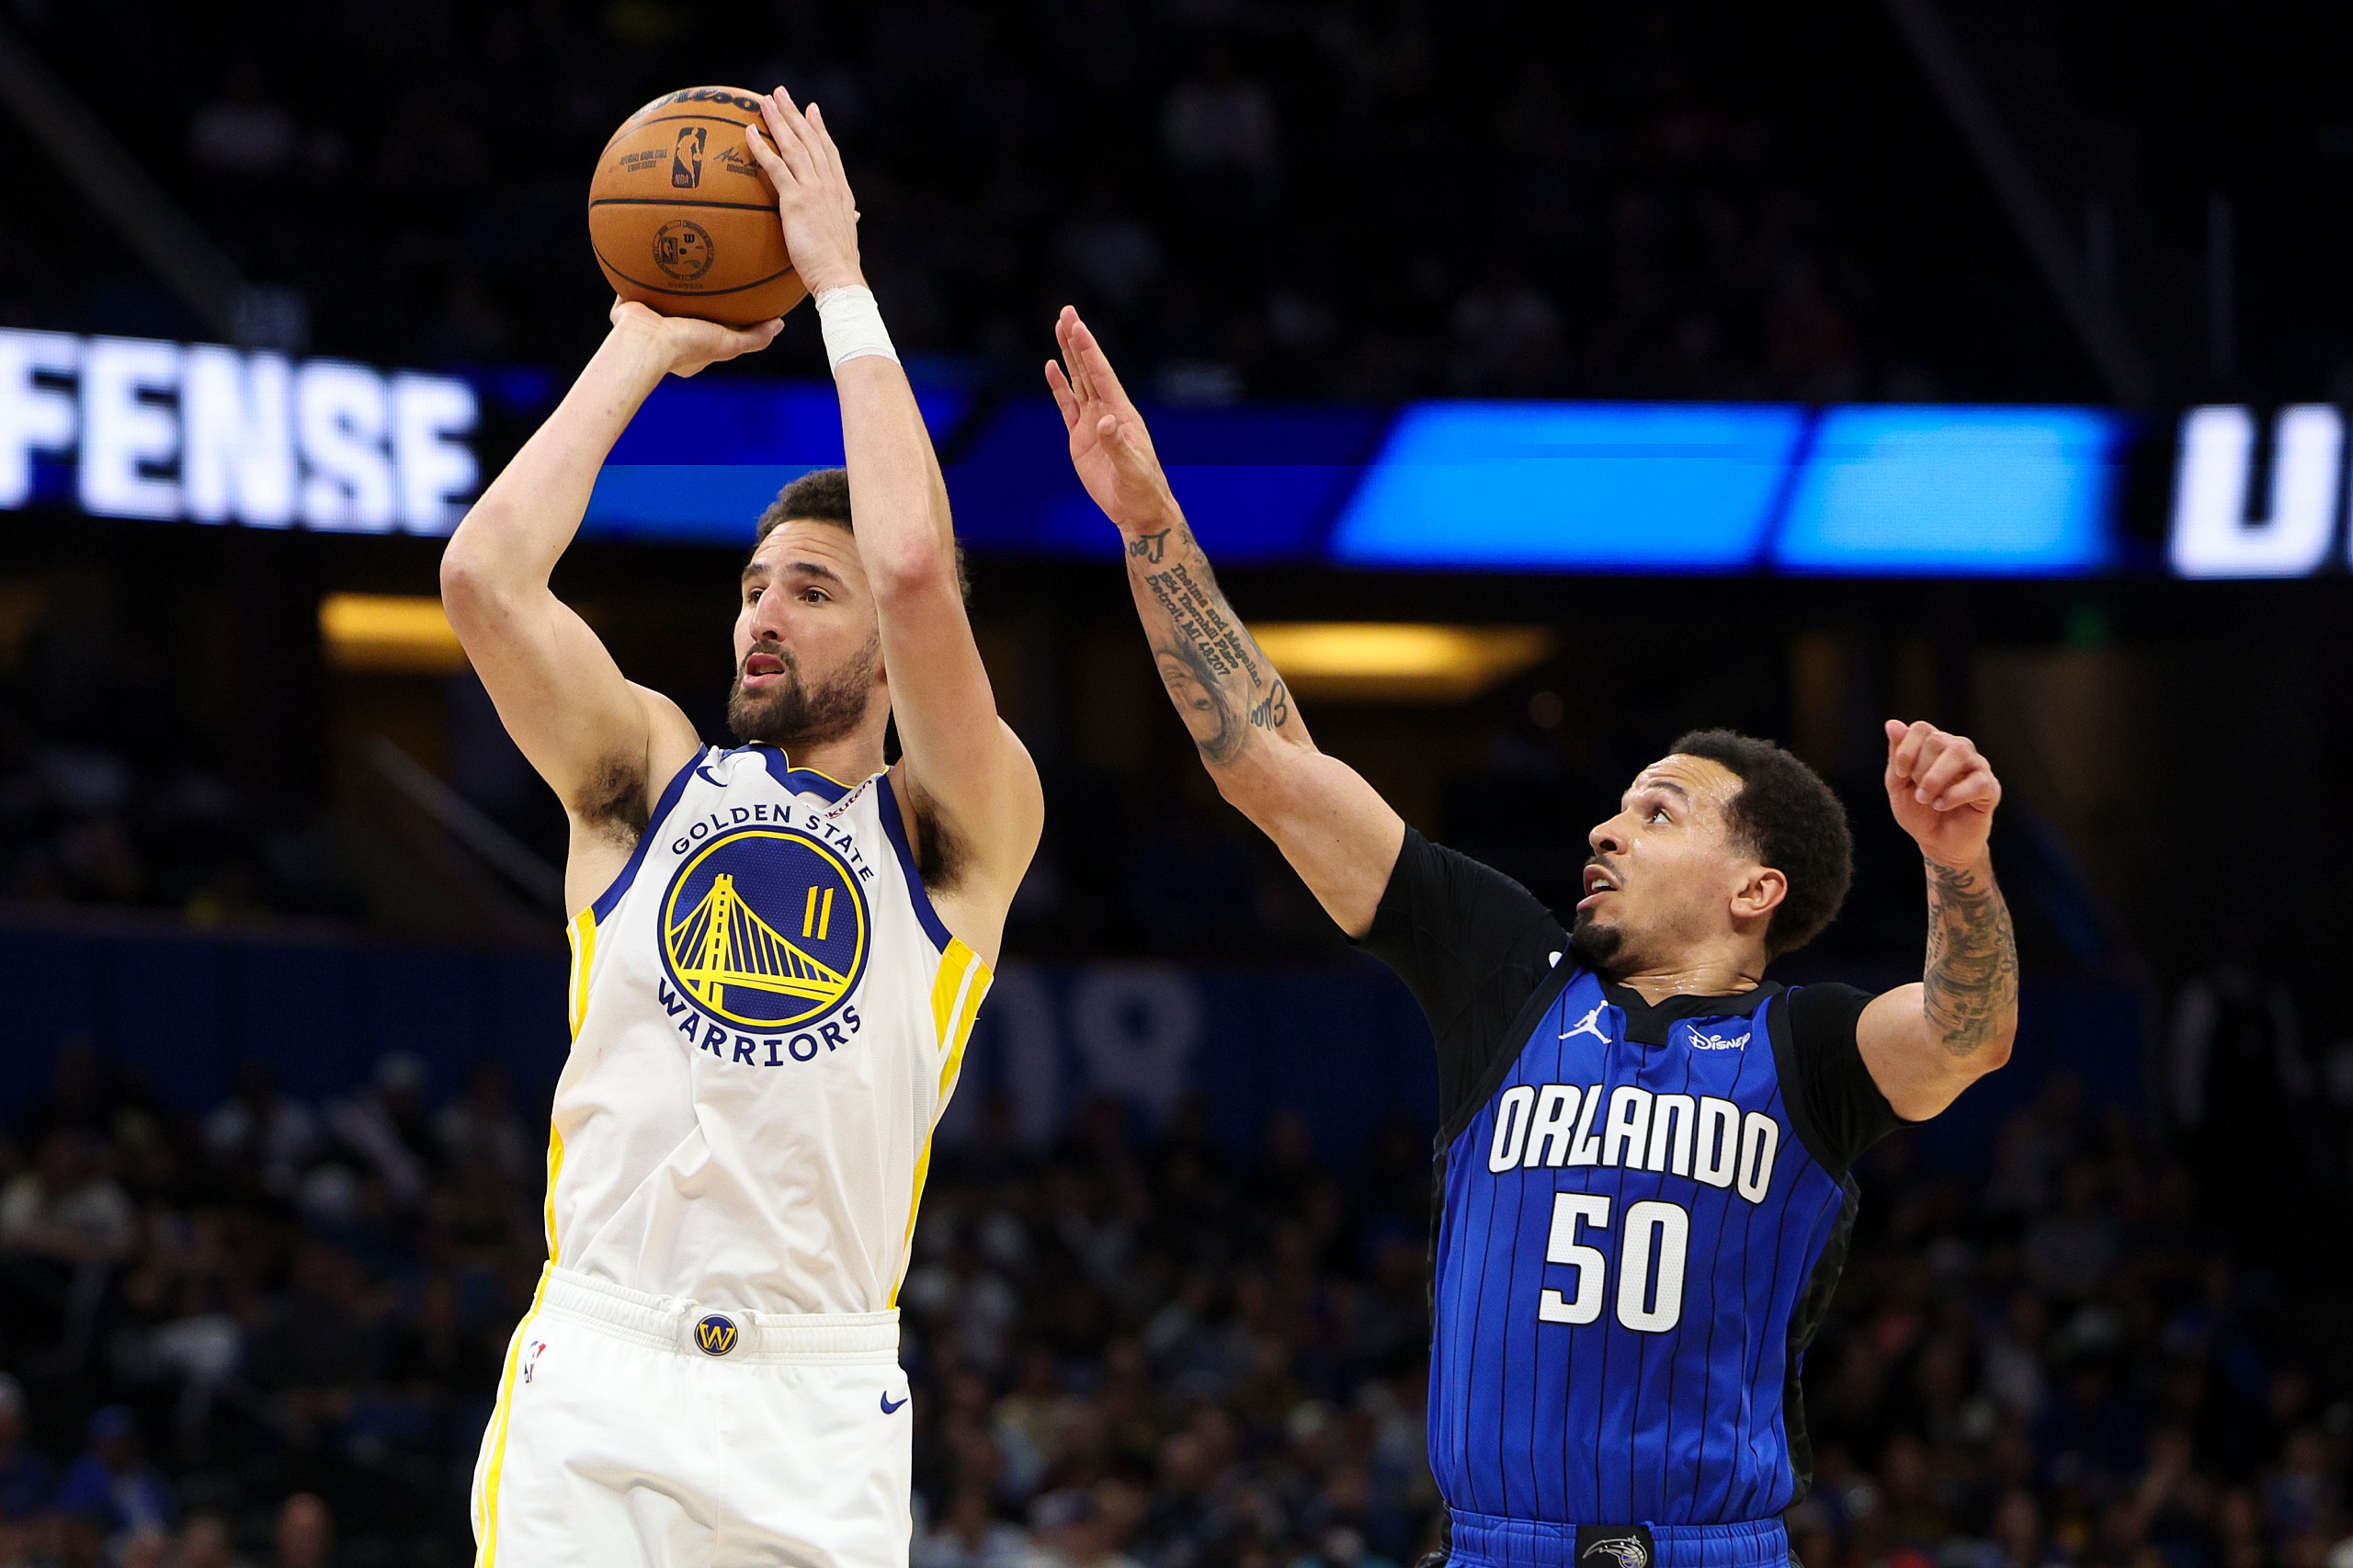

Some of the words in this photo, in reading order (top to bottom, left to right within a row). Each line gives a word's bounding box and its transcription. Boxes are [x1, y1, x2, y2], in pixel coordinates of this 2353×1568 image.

[0, 327, 478, 539] FENSE
[2167, 403, 2353, 581] U
[1144, 574, 1185, 622] Detroit,
[1181, 619, 1203, 641] MI
[1198, 642, 1231, 676] 48207
[1206, 608, 1228, 631] and
[671, 804, 791, 855] GOLDEN
[805, 814, 874, 882] STATE
[801, 885, 834, 940] 11
[658, 977, 861, 1067] WARRIORS
[1487, 1083, 1780, 1205] ORLANDO
[1538, 1191, 1690, 1334] 50
[699, 1323, 736, 1352] W
